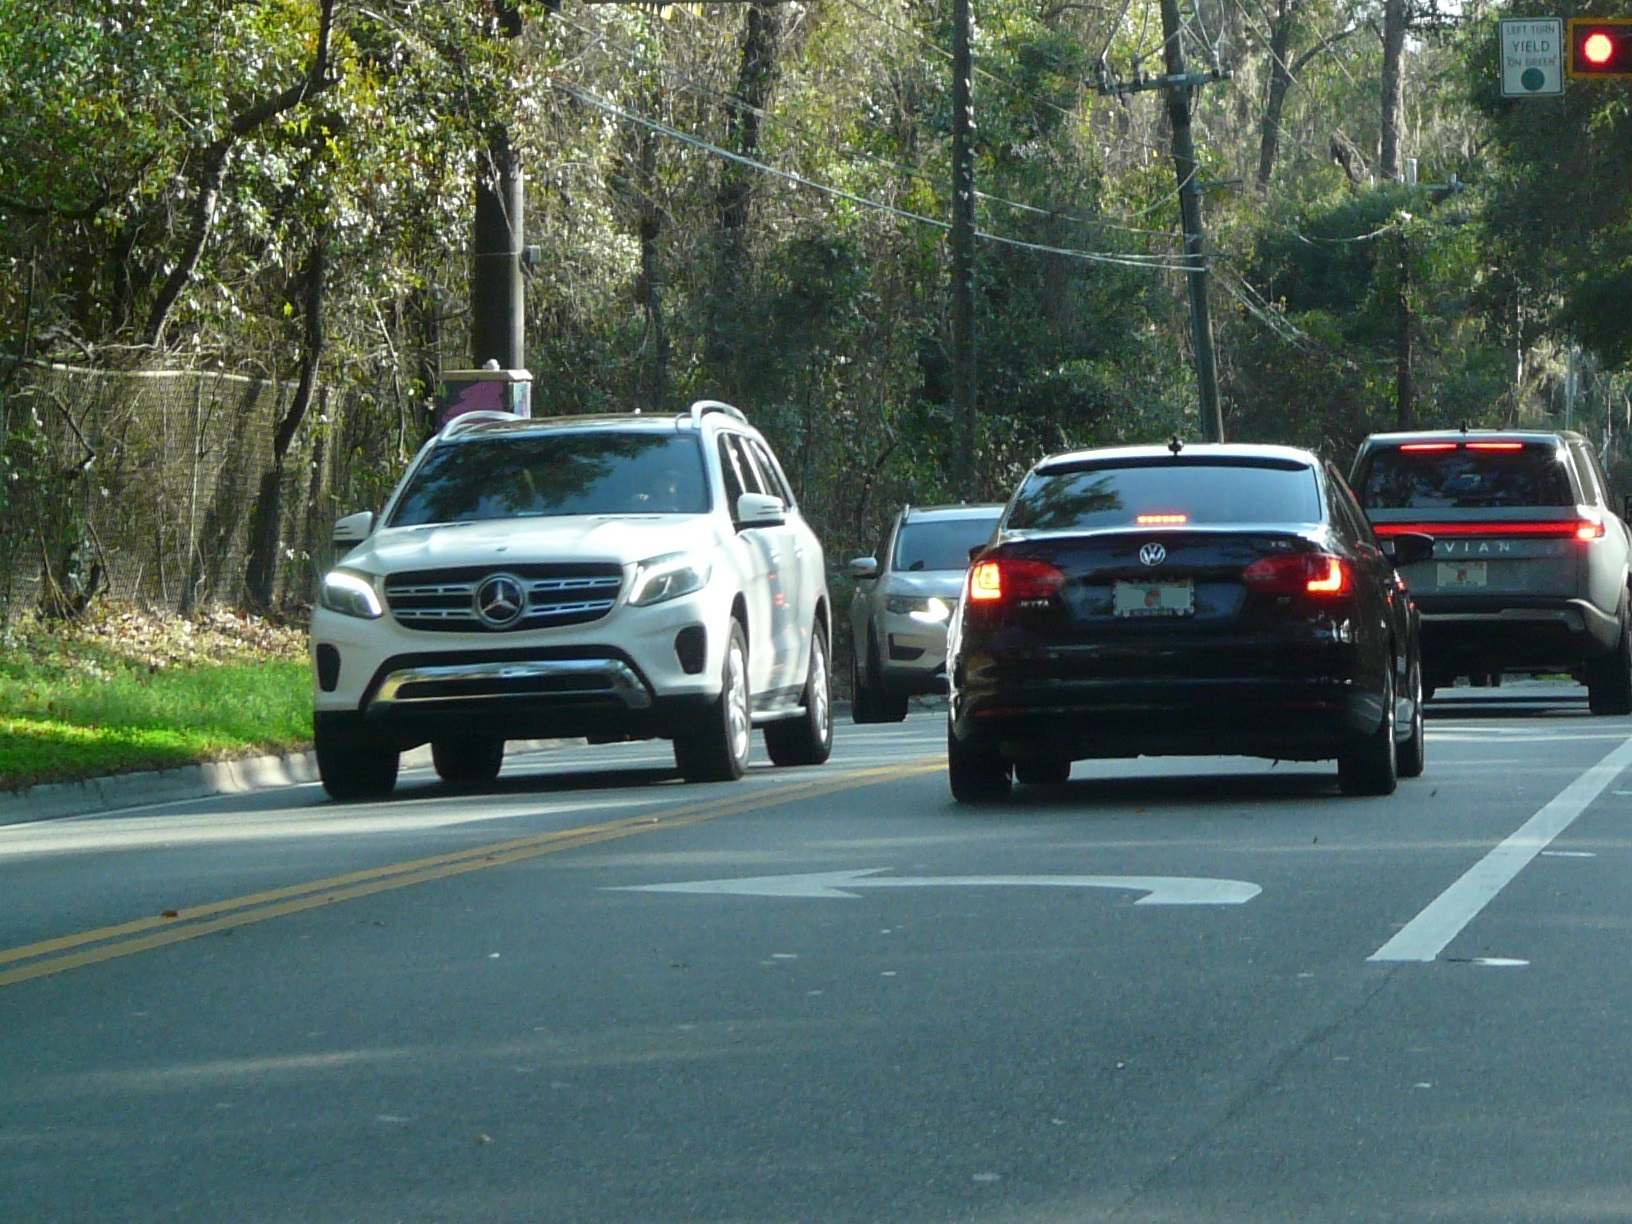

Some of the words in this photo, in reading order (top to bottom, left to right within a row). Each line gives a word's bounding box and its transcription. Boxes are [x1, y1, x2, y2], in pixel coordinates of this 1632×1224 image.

[1507, 24, 1527, 35] LEFT
[1531, 24, 1555, 35] TURN
[1512, 40, 1550, 52] YIELD
